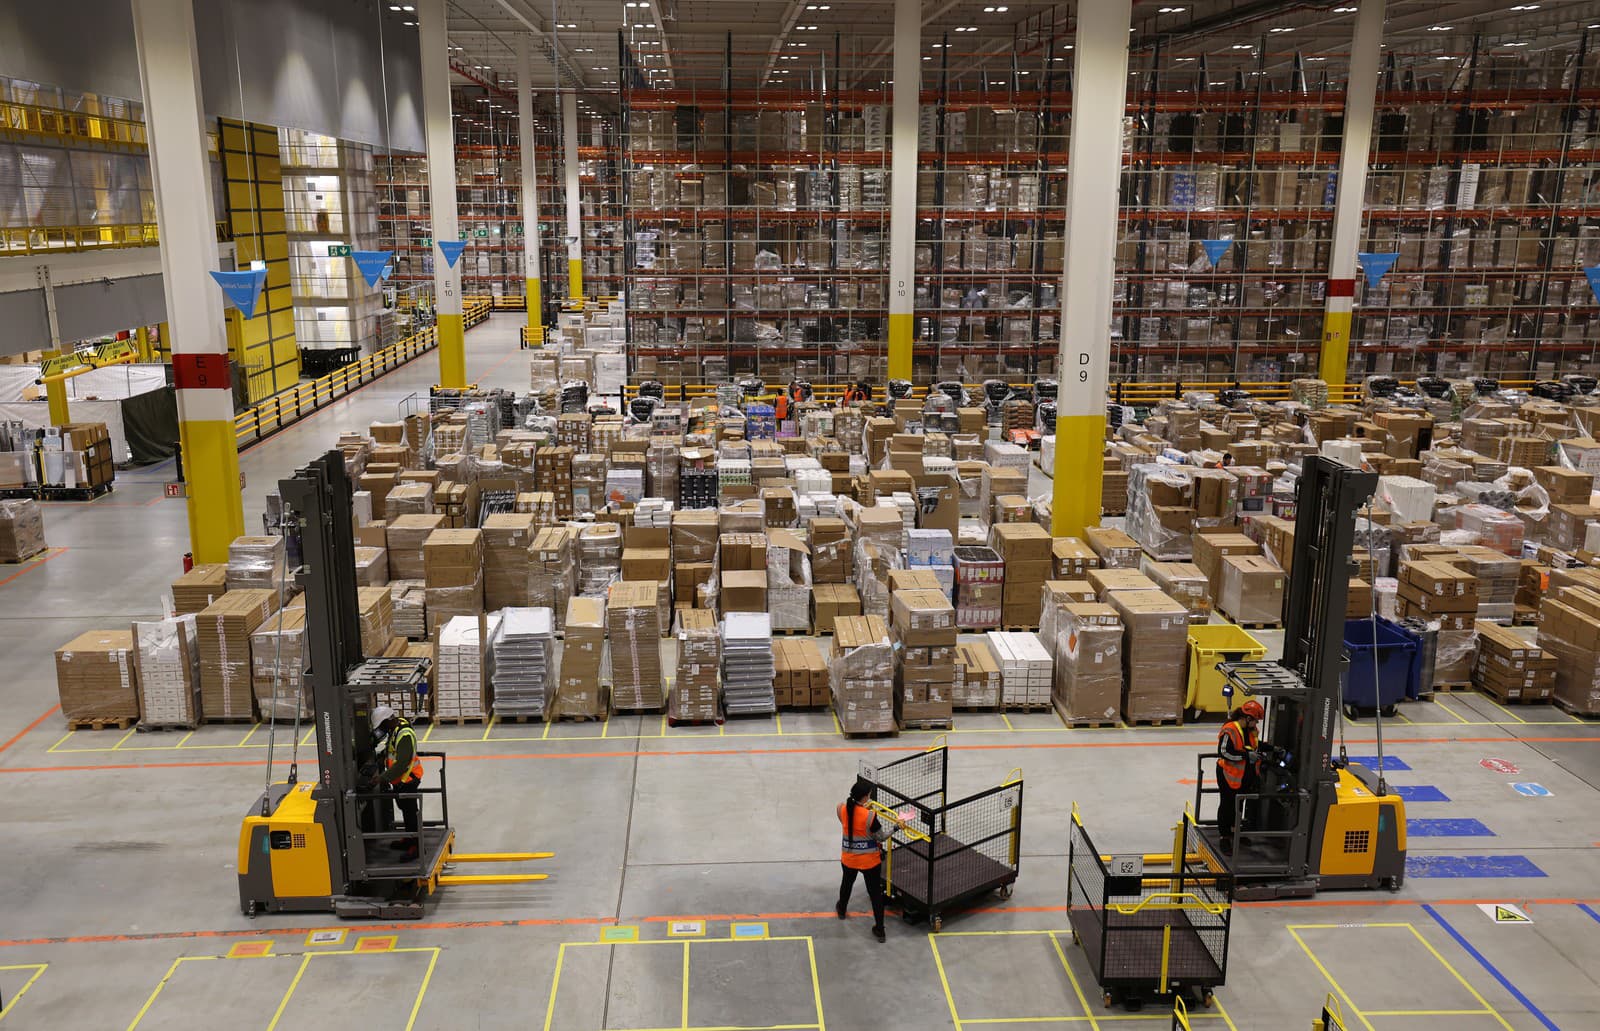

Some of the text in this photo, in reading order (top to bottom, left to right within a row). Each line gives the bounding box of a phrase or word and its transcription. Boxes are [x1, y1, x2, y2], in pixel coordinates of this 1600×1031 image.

[445, 280, 451, 288] E
[898, 280, 905, 288] D
[196, 356, 207, 369] E
[1079, 352, 1090, 365] D
[198, 374, 207, 386] 9
[1079, 370, 1088, 383] 9
